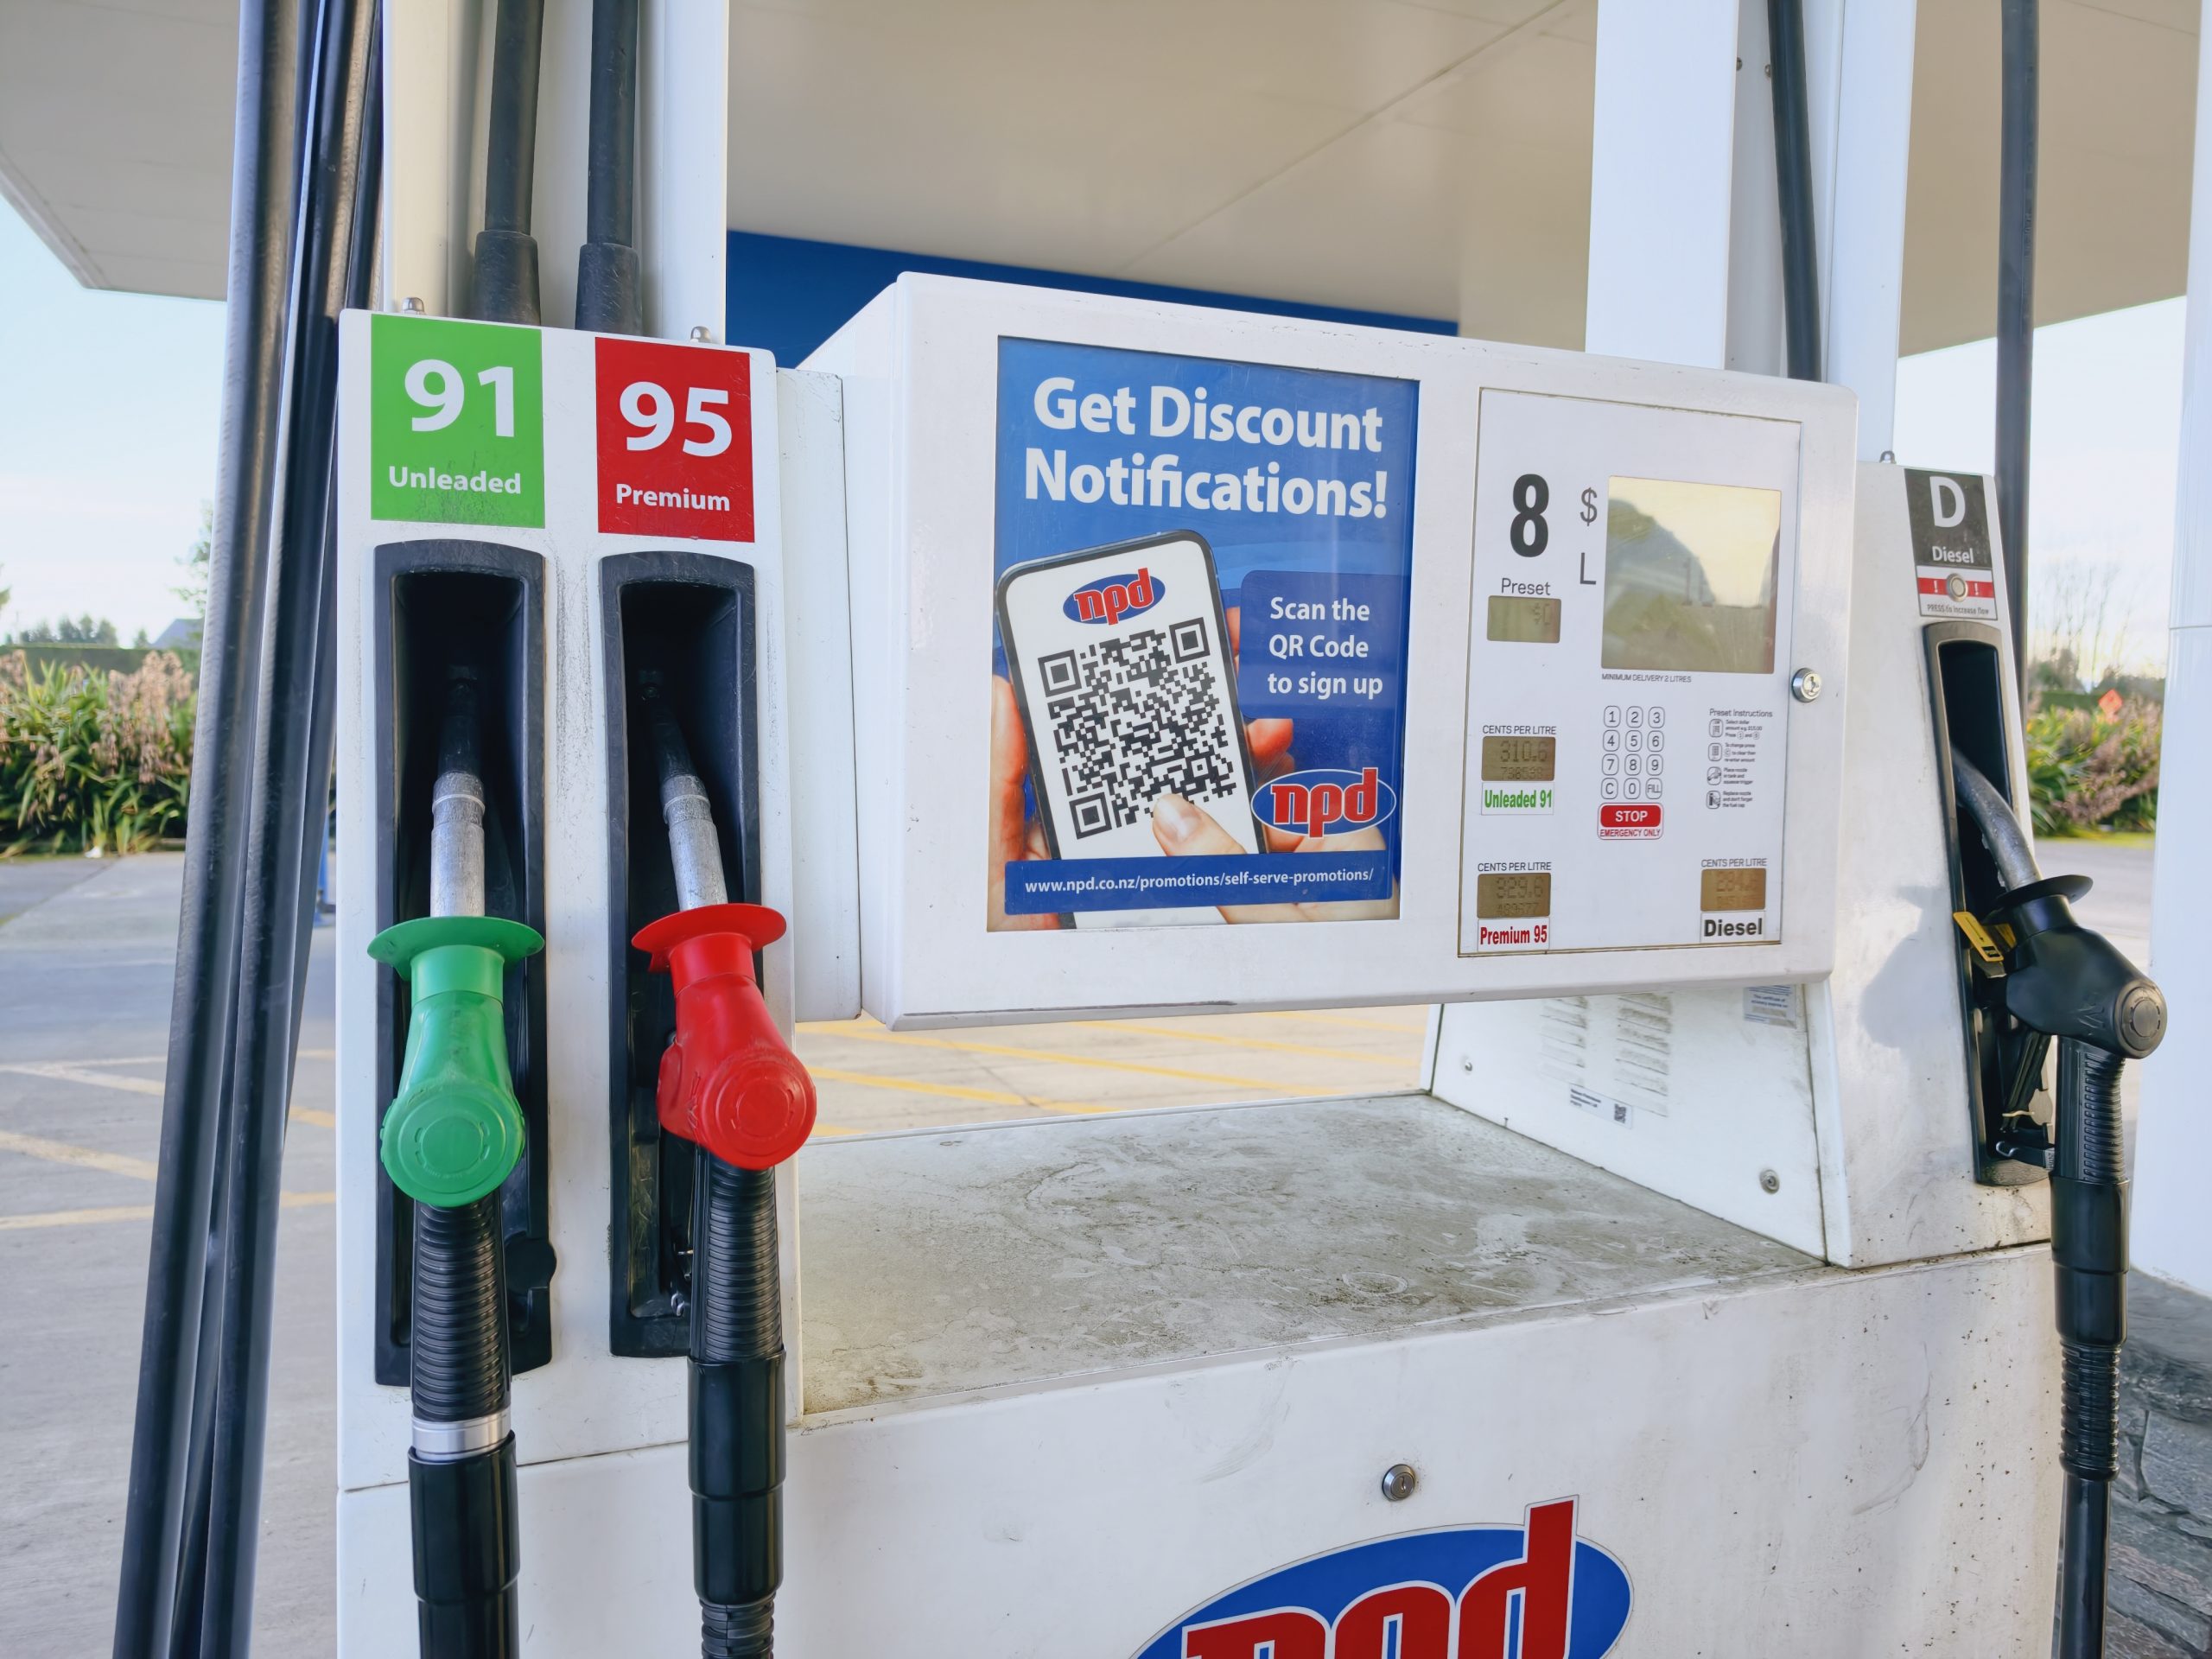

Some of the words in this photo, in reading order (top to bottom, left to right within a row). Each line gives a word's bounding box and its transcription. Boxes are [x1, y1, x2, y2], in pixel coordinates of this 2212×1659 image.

[404, 359, 515, 438] 91
[619, 381, 733, 457] 95
[1033, 377, 1136, 435] Get
[1150, 386, 1383, 453] Discount
[388, 466, 522, 495] Unleaded
[1025, 447, 1388, 518] Notifications!
[616, 483, 730, 512] Premium
[1929, 476, 1966, 528] D
[1510, 474, 1549, 557] 8
[1932, 546, 1974, 563] Diesel
[1580, 552, 1597, 585] L
[1073, 567, 1155, 626] npd
[1501, 577, 1551, 595] Preset
[1270, 596, 1325, 620] Scan
[1332, 598, 1370, 621] the
[1268, 634, 1304, 660] QR
[1309, 635, 1369, 658] Code
[1268, 673, 1293, 694] to
[1298, 671, 1346, 700] sign
[1353, 677, 1382, 700] up
[1483, 725, 1512, 734] CENTS
[1533, 726, 1556, 734] LITRE
[1609, 711, 1616, 722] 1
[1631, 711, 1639, 722] 2
[1653, 712, 1661, 723] 3
[1607, 735, 1615, 746] 4
[1630, 735, 1637, 747] 5
[1652, 736, 1660, 747] 6
[1607, 760, 1615, 771] 7
[1630, 760, 1637, 771] 8
[1651, 760, 1659, 771] 9
[1484, 790, 1536, 808] Unleaded
[1540, 789, 1552, 808] 91
[1605, 783, 1614, 794] C
[1647, 785, 1662, 793] FILL
[1270, 766, 1379, 839] npd
[1615, 810, 1648, 822] STOP
[1478, 862, 1507, 872] CENTS
[1509, 862, 1526, 871] PER
[1528, 861, 1552, 871] LITRE
[1700, 859, 1727, 868] CENTS
[1729, 858, 1745, 867] PER
[1745, 858, 1768, 867] LITRE
[1025, 868, 1375, 893] www.npd.co.nz/promotions/self-serve-promotions/
[1480, 926, 1530, 944] Premium
[1534, 925, 1548, 943] 95
[1704, 918, 1763, 937] Diesel
